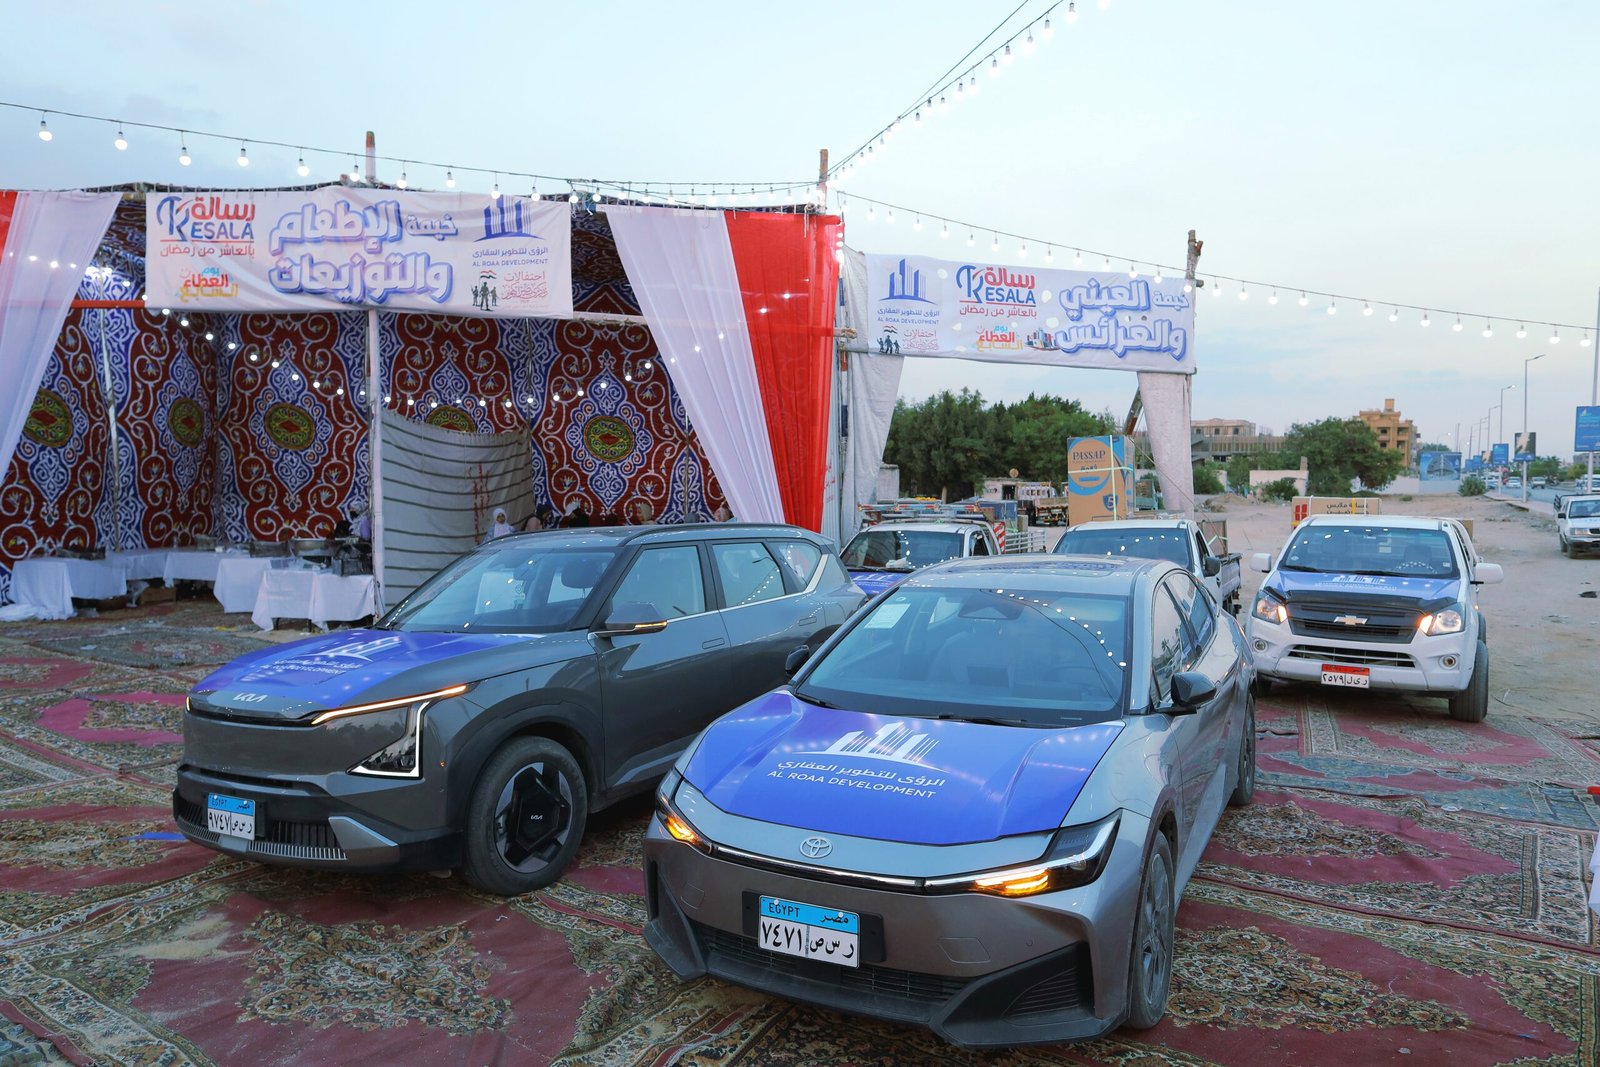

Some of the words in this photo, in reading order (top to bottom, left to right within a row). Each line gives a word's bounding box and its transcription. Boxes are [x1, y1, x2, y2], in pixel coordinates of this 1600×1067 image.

[191, 197, 255, 221] رسالة
[269, 199, 402, 256] الإطعام
[405, 213, 459, 242] خيمة
[160, 245, 196, 257] رمضان
[197, 248, 215, 257] من
[219, 245, 255, 259] بالعاشر
[501, 258, 549, 266] DEVELOPMENT
[183, 273, 229, 288] العطاء
[268, 252, 453, 304] والتوزيعات
[984, 266, 1036, 290] رسالة
[1059, 278, 1151, 322] العيني
[1152, 291, 1190, 312] خيمة
[959, 304, 989, 317] رمضان
[990, 309, 1005, 318] من
[1007, 306, 1037, 319] بالعاشر
[979, 330, 1015, 343] العطاء
[1054, 315, 1187, 362] والعرائس
[1322, 673, 1344, 684] ٢٥٧٩
[835, 766, 897, 781] للتطوير
[897, 775, 946, 787] الرؤى
[767, 770, 784, 779] AL
[787, 772, 824, 784] ROAA
[828, 777, 937, 799] DEVELOPMENT
[208, 811, 230, 831] ٩٧٤٧
[768, 902, 800, 918] EGYPT
[820, 913, 849, 924] مصر
[761, 920, 802, 952] ٧٤٧١
